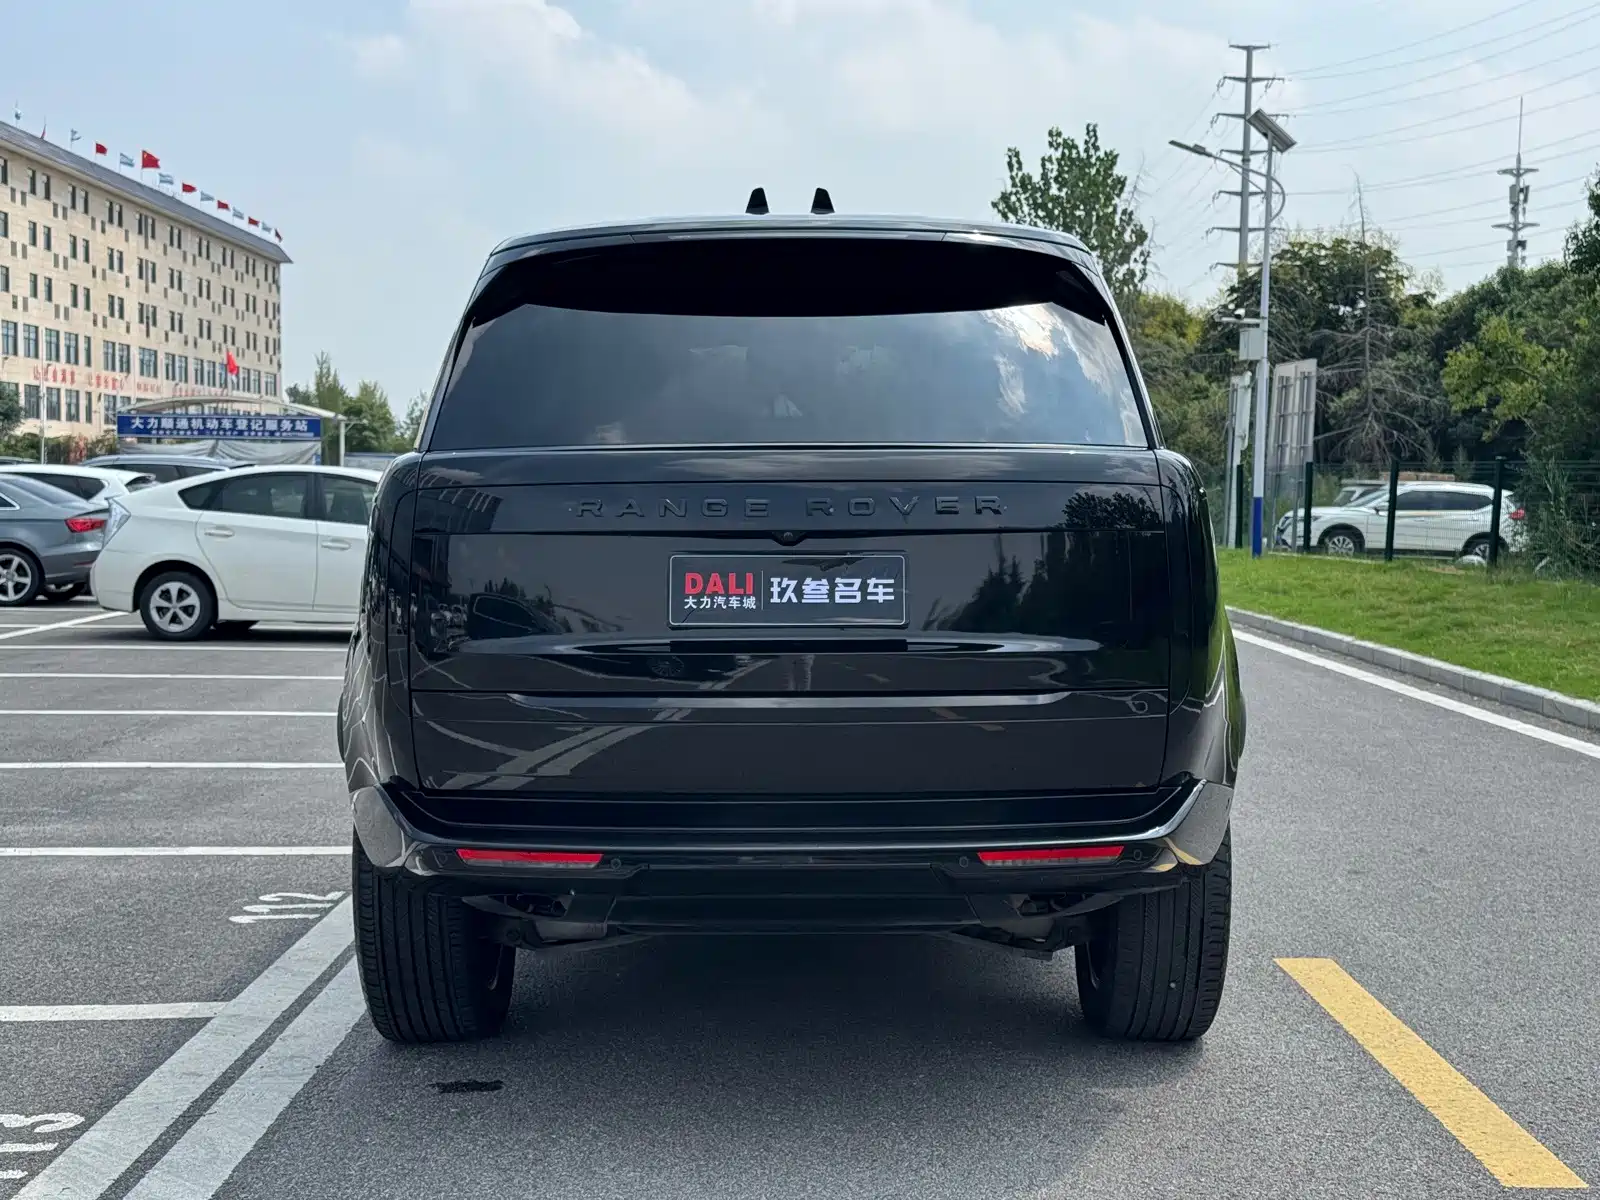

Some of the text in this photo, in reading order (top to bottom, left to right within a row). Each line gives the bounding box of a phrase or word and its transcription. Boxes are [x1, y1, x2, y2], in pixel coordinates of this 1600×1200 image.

[576, 495, 1004, 518] RANGE ROVER
[684, 572, 754, 595] DALI
[770, 577, 895, 604] 玖叁名车
[684, 596, 757, 610] 大力汽车城
